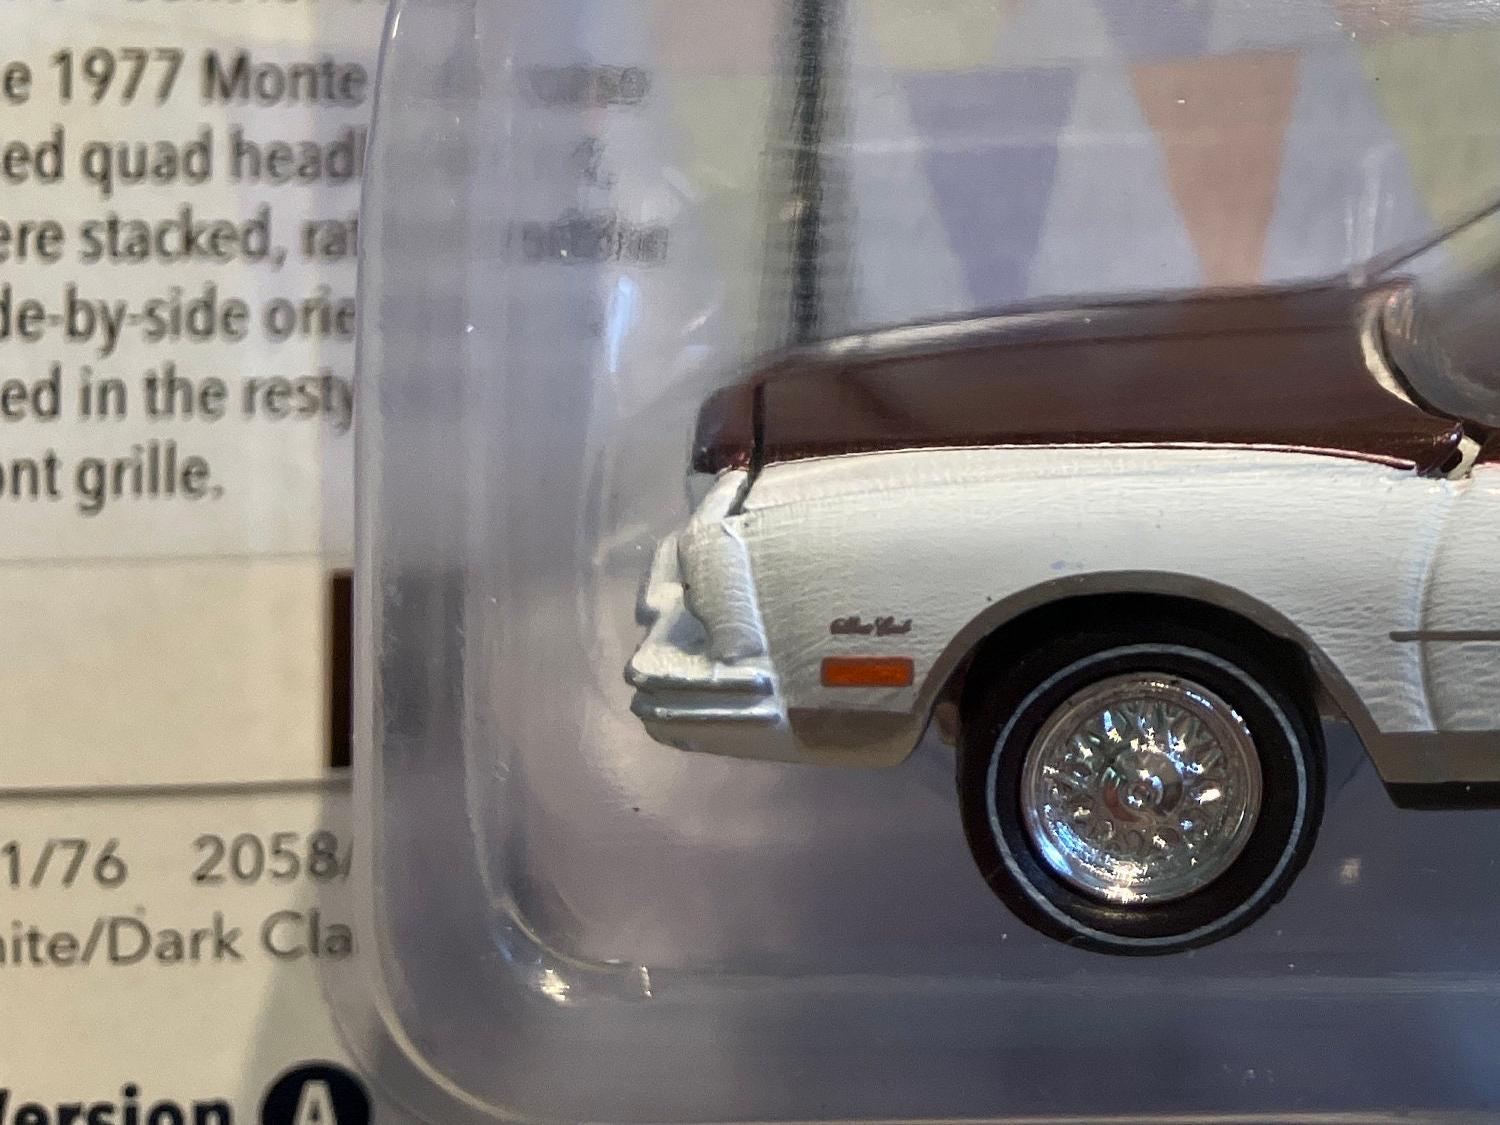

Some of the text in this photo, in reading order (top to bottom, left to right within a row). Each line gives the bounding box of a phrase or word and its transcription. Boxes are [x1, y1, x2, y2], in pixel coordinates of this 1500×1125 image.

[50, 45, 185, 107] 1977
[203, 47, 369, 108] Monte
[79, 121, 214, 201] quad
[78, 201, 287, 272] stacked,
[78, 363, 128, 421] in
[143, 360, 230, 423] the
[0, 439, 226, 515] nt grille.
[0, 909, 248, 969] ite/Dark
[0, 1081, 234, 1125] ersion
